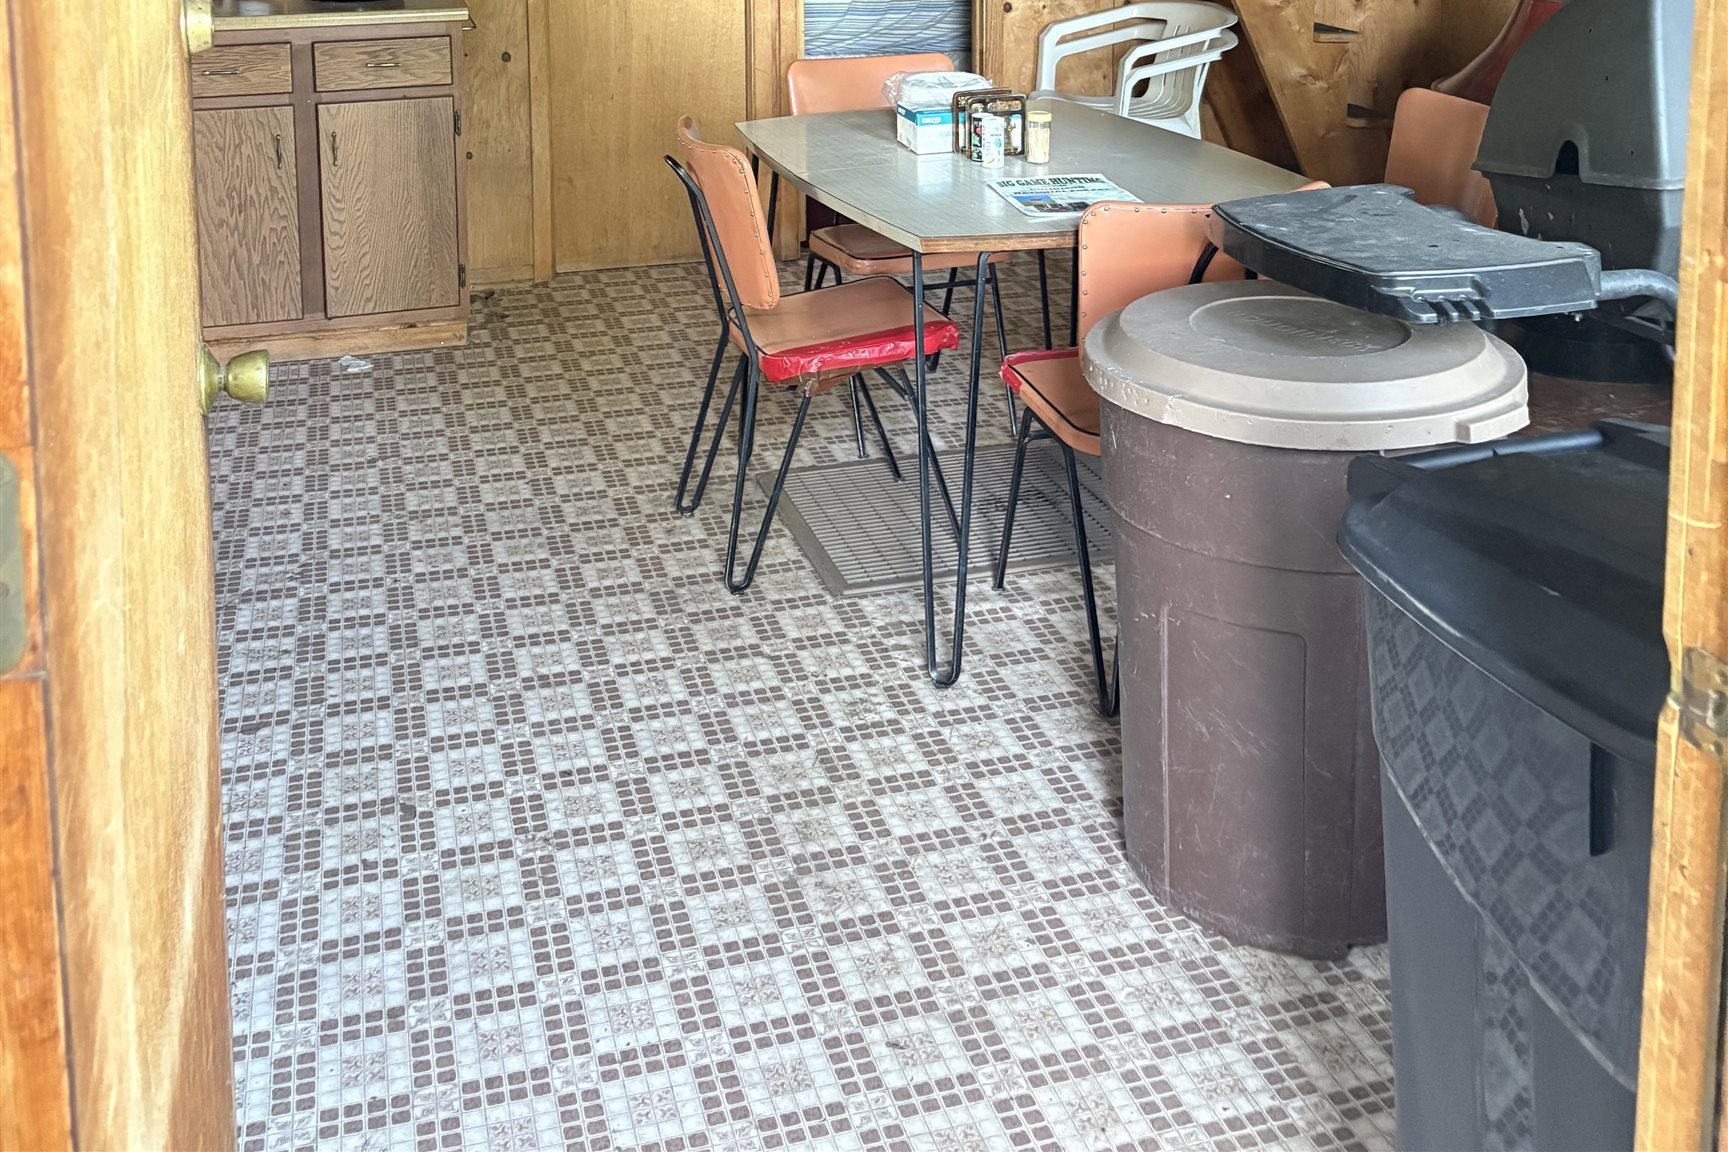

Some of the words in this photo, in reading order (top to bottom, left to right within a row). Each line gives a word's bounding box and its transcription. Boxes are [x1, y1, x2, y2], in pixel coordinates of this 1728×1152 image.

[997, 180, 1015, 188] BIG
[1016, 178, 1049, 186] GAME
[1048, 177, 1105, 185] HUNTING
